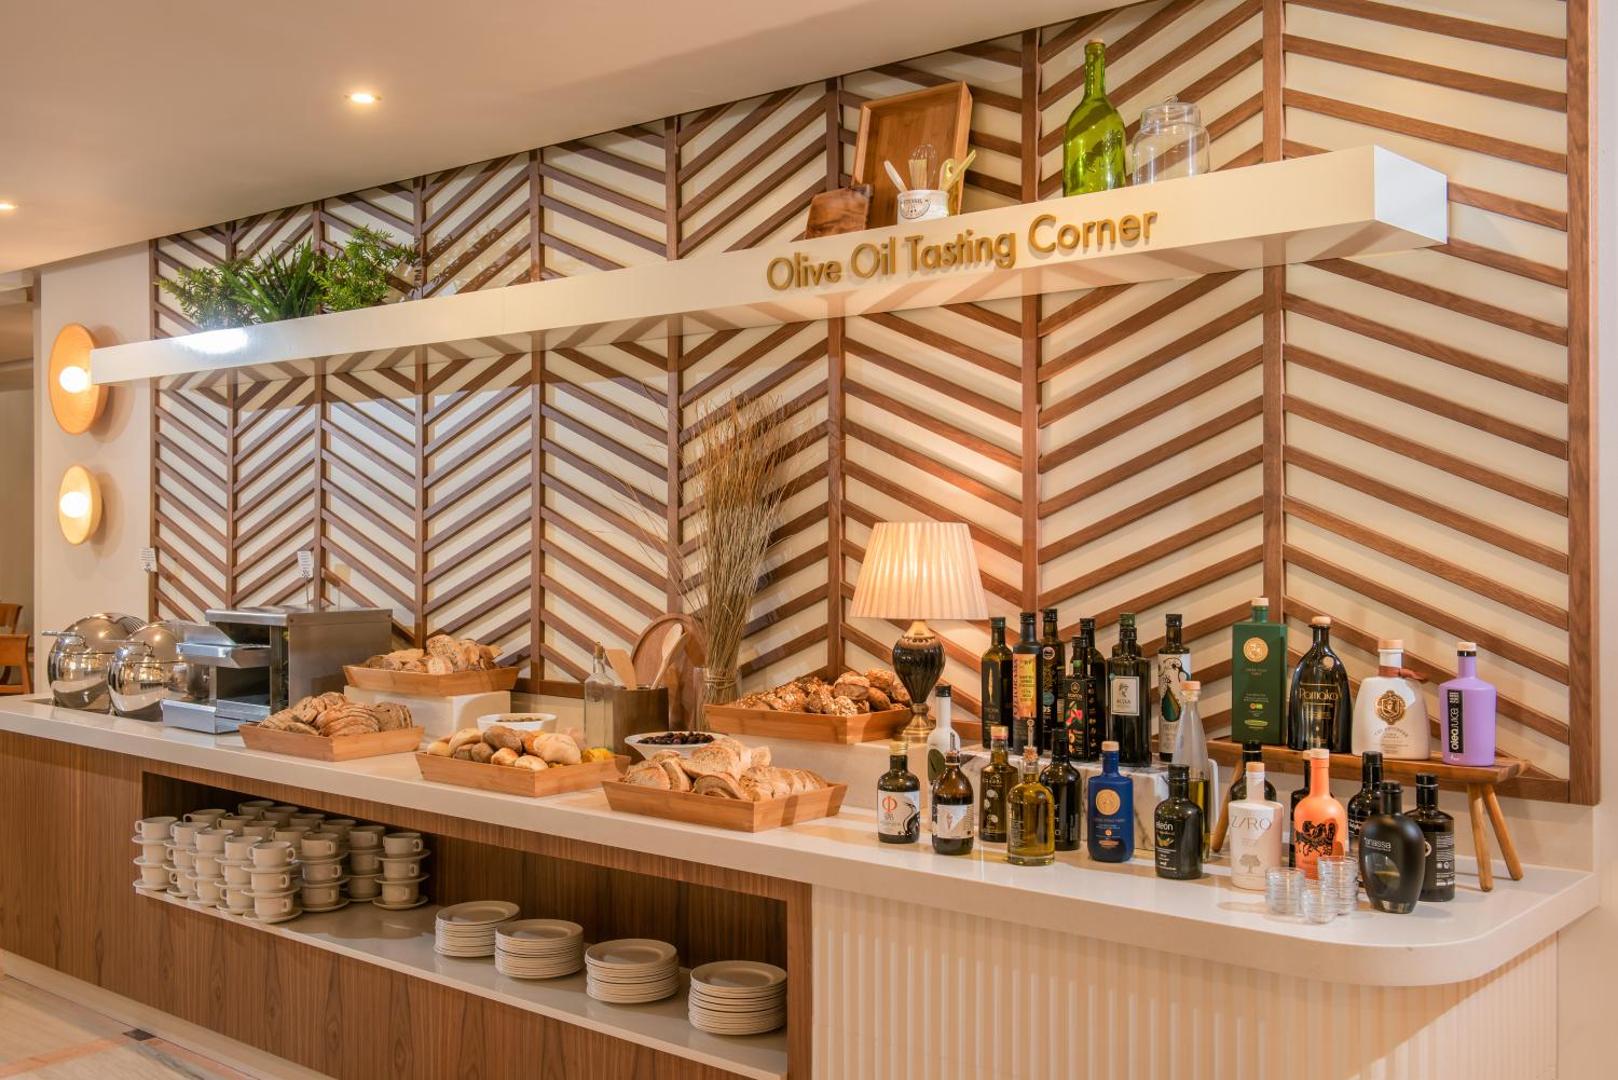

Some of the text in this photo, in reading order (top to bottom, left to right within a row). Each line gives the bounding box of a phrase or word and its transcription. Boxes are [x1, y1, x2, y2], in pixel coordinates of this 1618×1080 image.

[767, 211, 1158, 290] Olive Oil Tasting Corner
